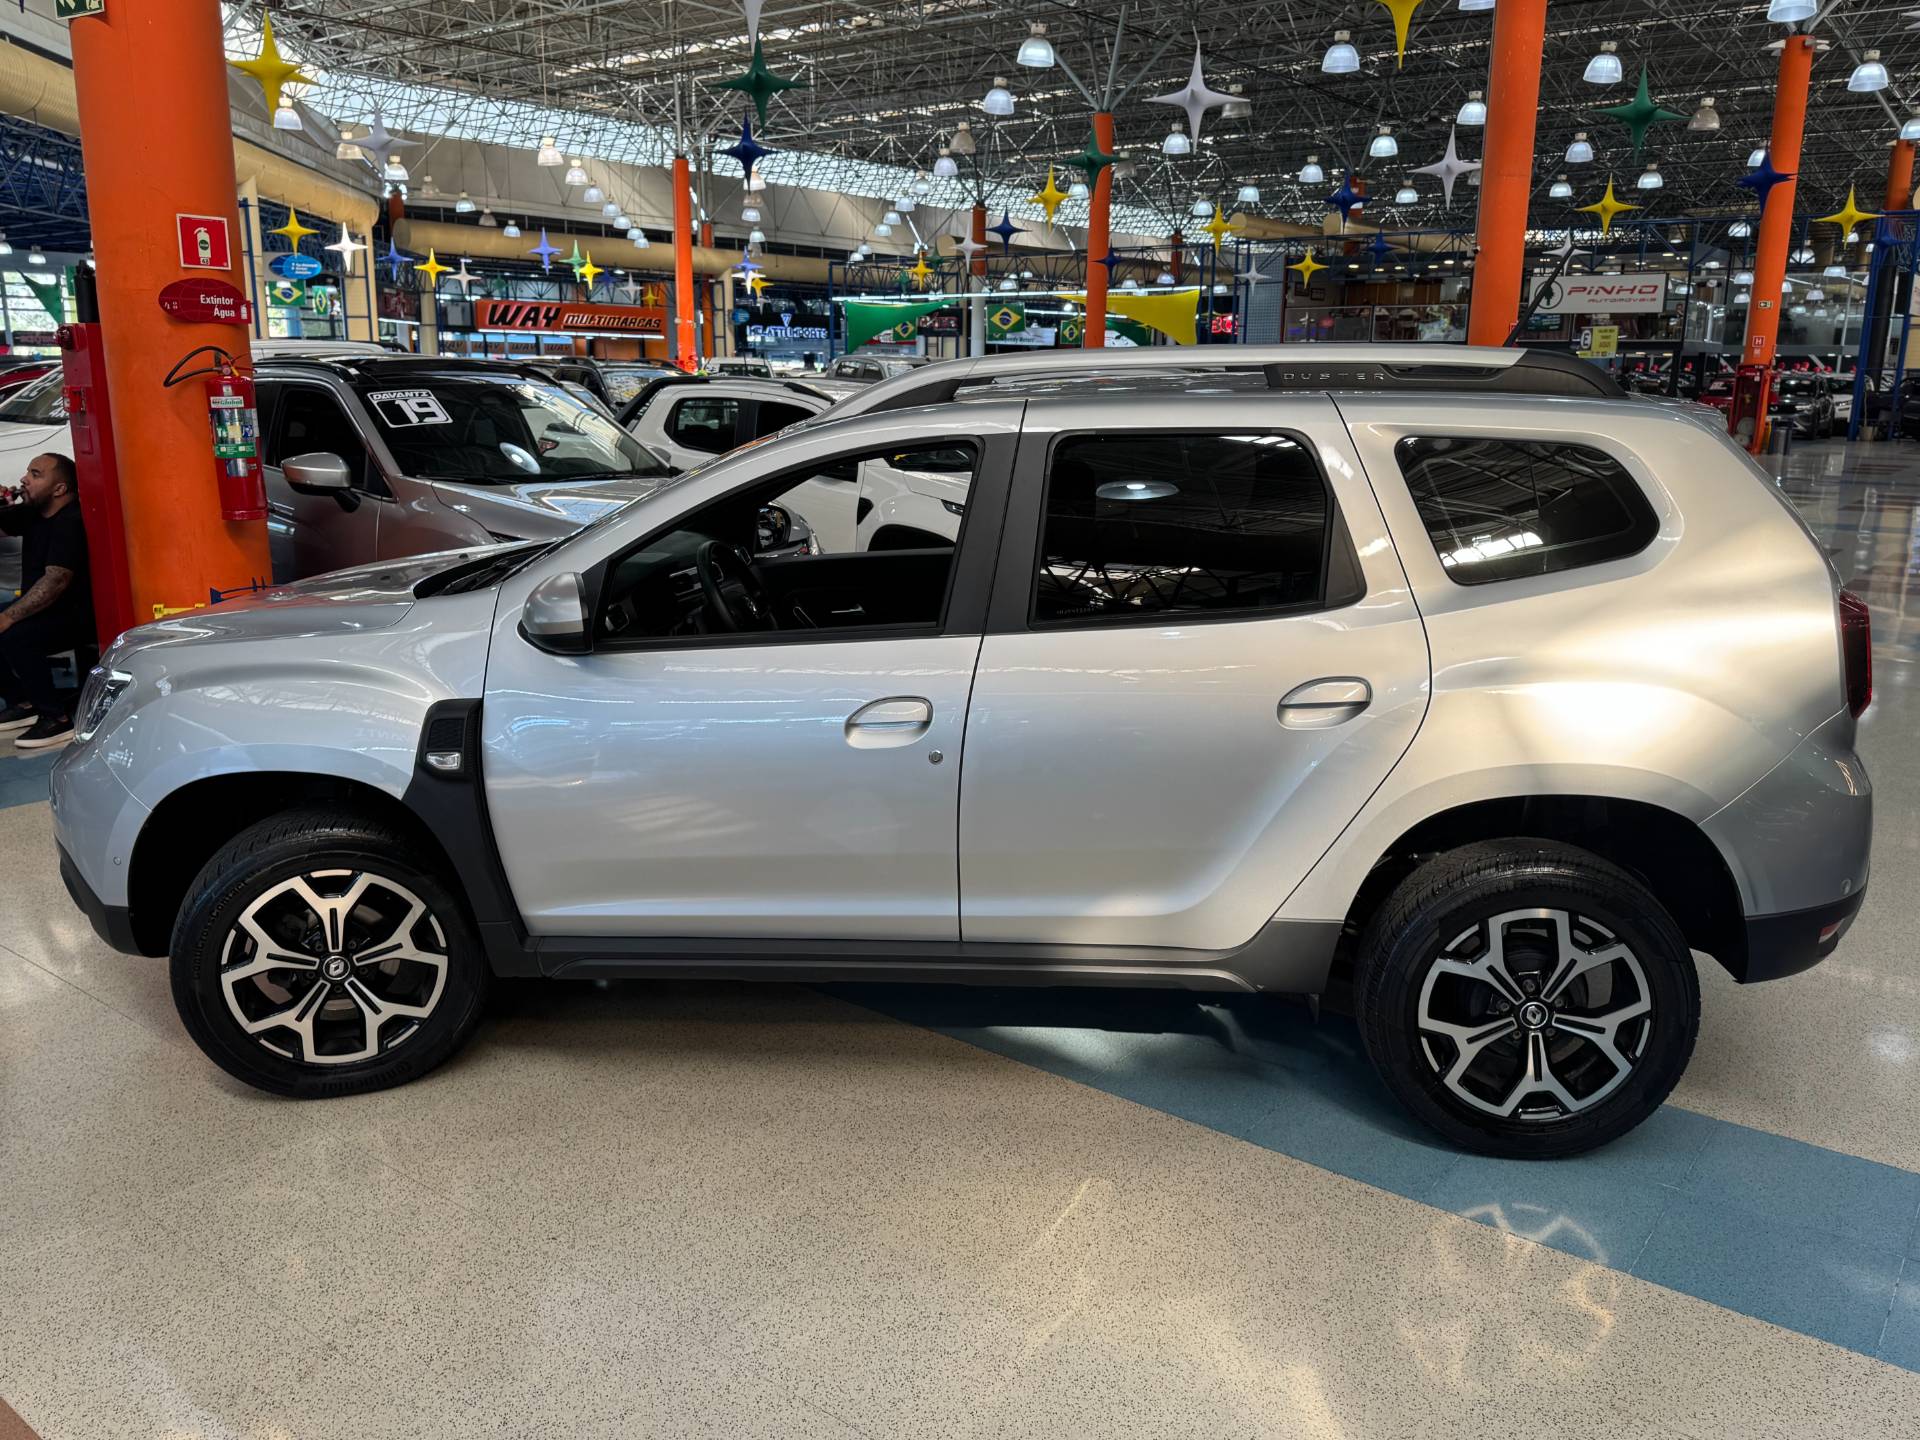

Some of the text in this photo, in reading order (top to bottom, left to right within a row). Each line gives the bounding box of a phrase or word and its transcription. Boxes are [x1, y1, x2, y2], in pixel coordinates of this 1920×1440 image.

[200, 294, 234, 306] Extintor
[213, 305, 235, 319] Água
[487, 304, 662, 329] WAY MULTIMARCAS
[372, 391, 429, 400] DAVANTI
[394, 398, 448, 423] 19
